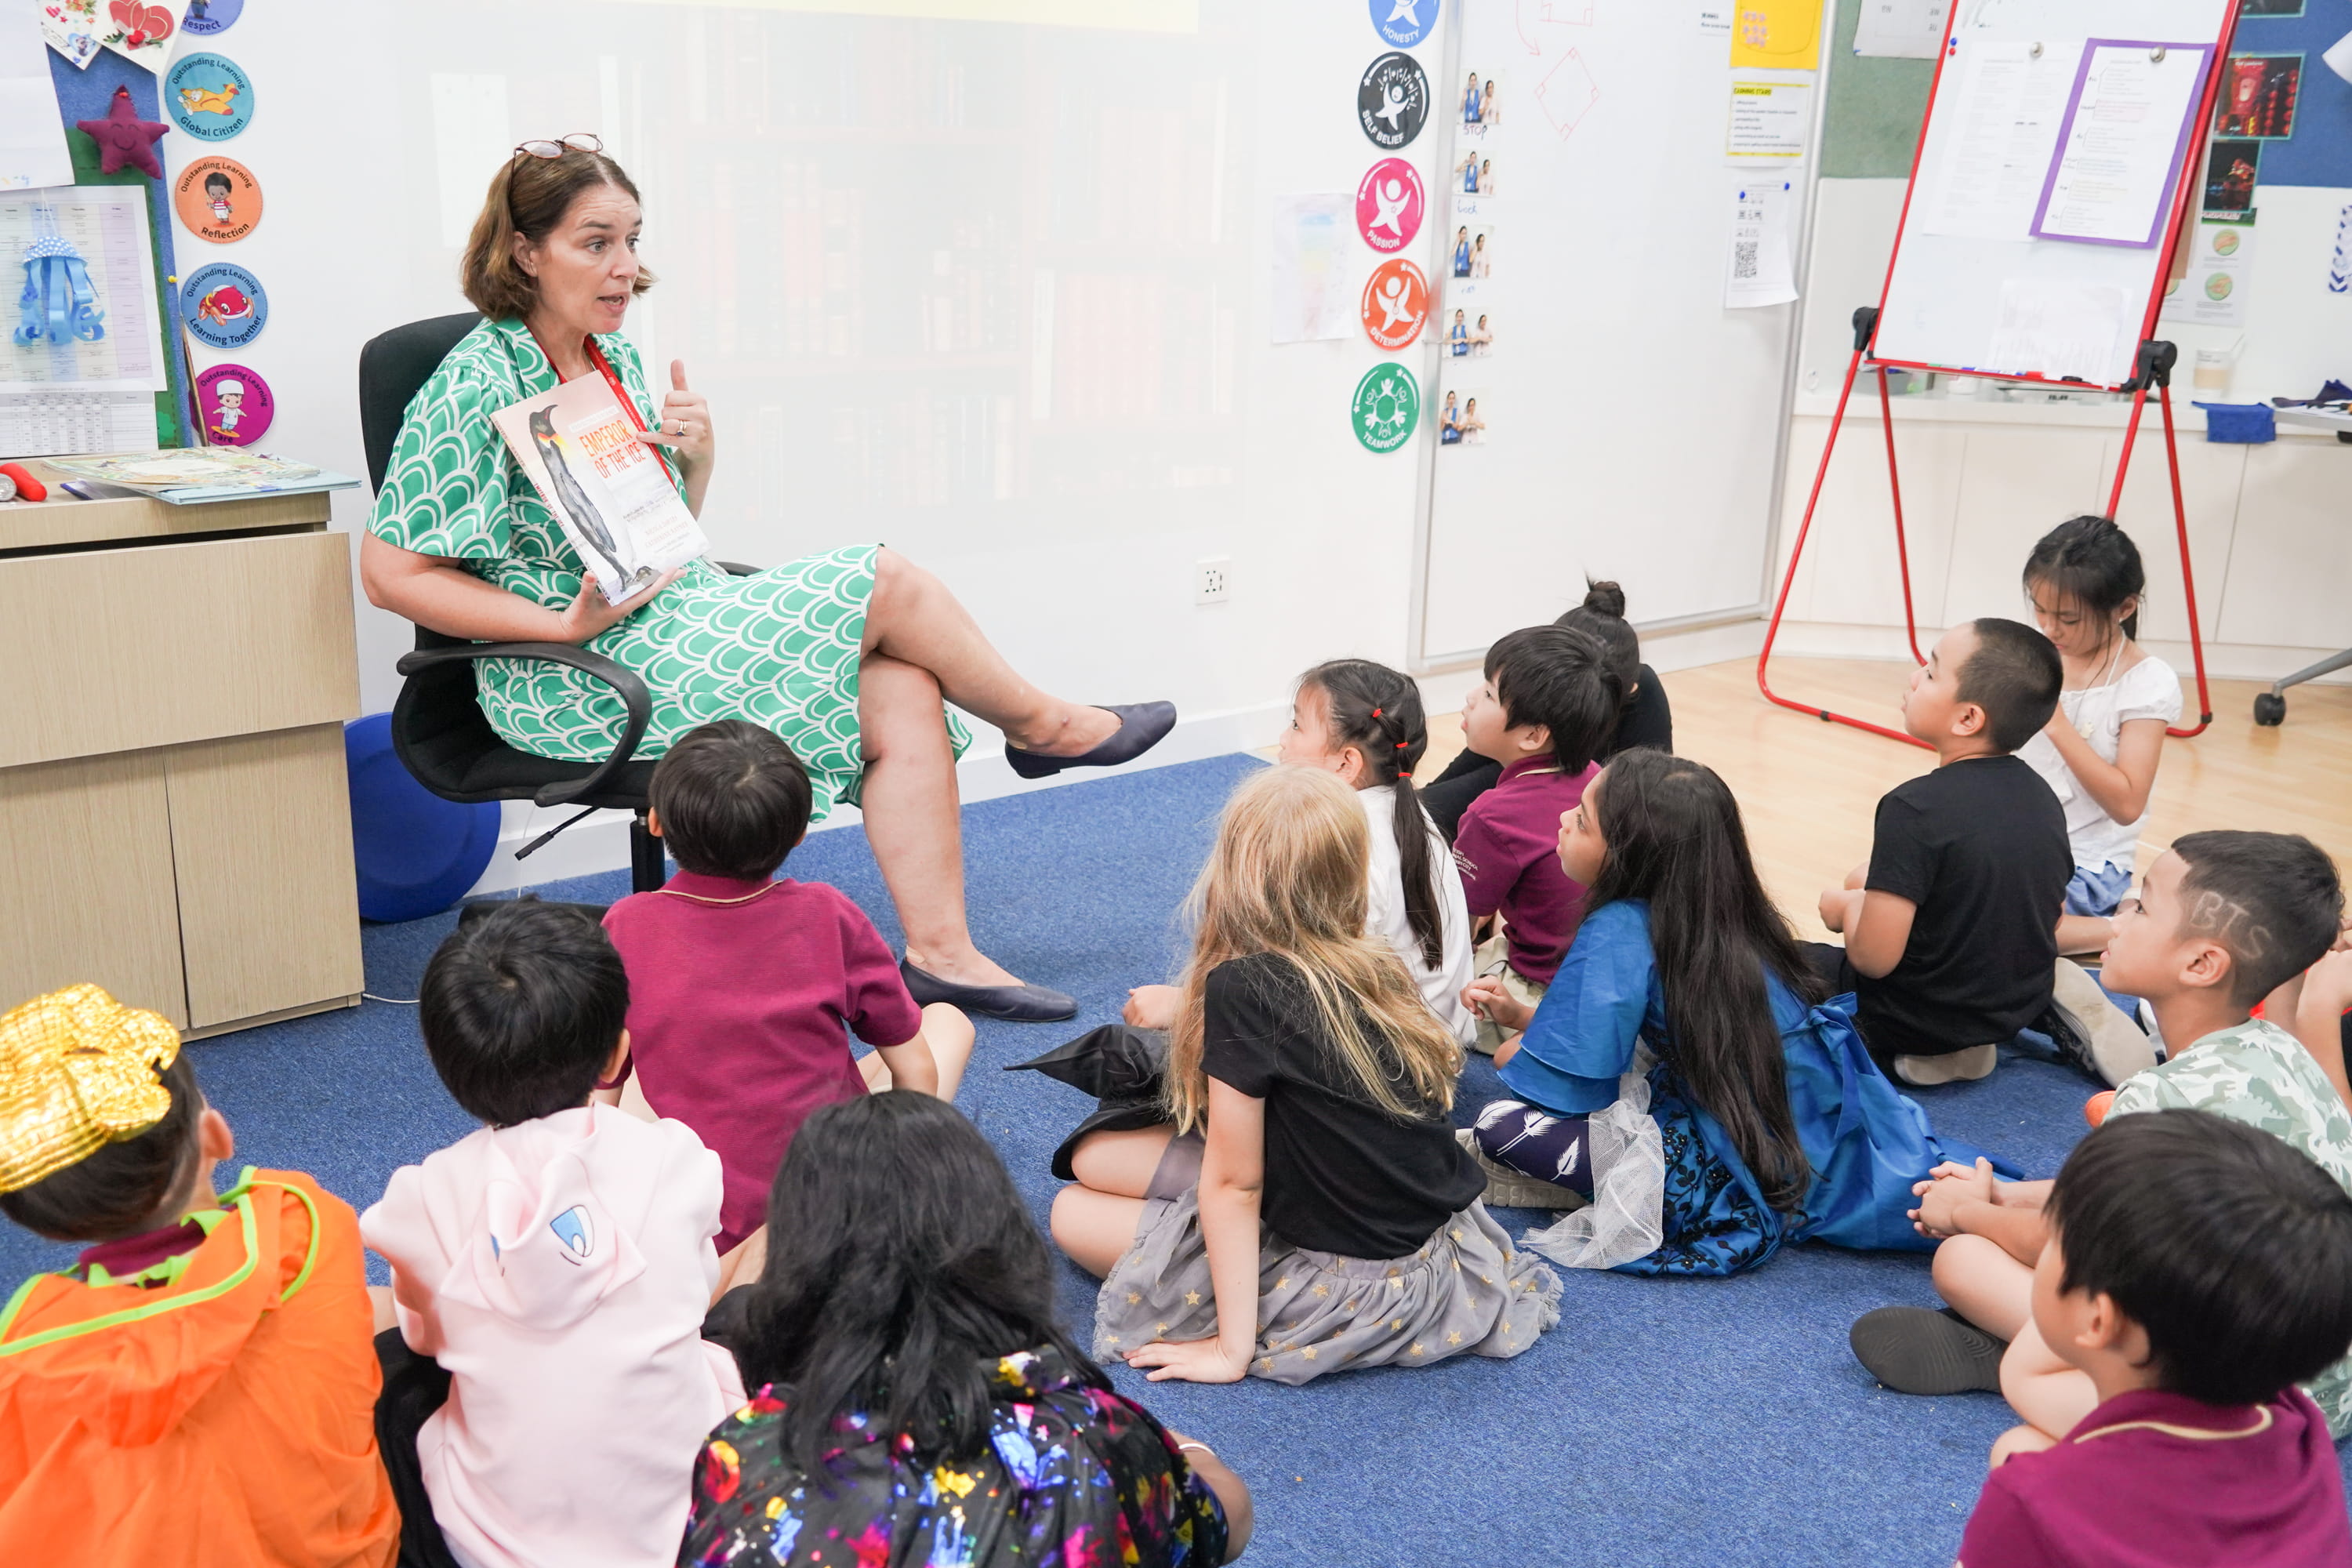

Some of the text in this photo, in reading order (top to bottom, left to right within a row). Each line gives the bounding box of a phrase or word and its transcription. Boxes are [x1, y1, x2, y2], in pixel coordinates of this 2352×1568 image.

[183, 17, 221, 31] Respect
[1382, 24, 1419, 43] HONESTY
[172, 57, 245, 89] Outstanding Learning
[180, 117, 243, 136] Global Citizen
[1363, 109, 1404, 144] SELF BELIEF
[181, 162, 252, 192] Outstanding Learning
[201, 223, 249, 238] Reflection
[1367, 229, 1400, 249] PASSION
[187, 268, 258, 297] Outstanding Learning
[190, 315, 261, 345] Learning Together
[1370, 310, 1424, 347] DETERMINATION
[200, 369, 267, 407] Outstanding Learning
[212, 431, 234, 443] Care
[579, 419, 633, 457] EMPEROR
[1363, 429, 1407, 448] TEAMWORK
[594, 441, 646, 478] OF THE ICE
